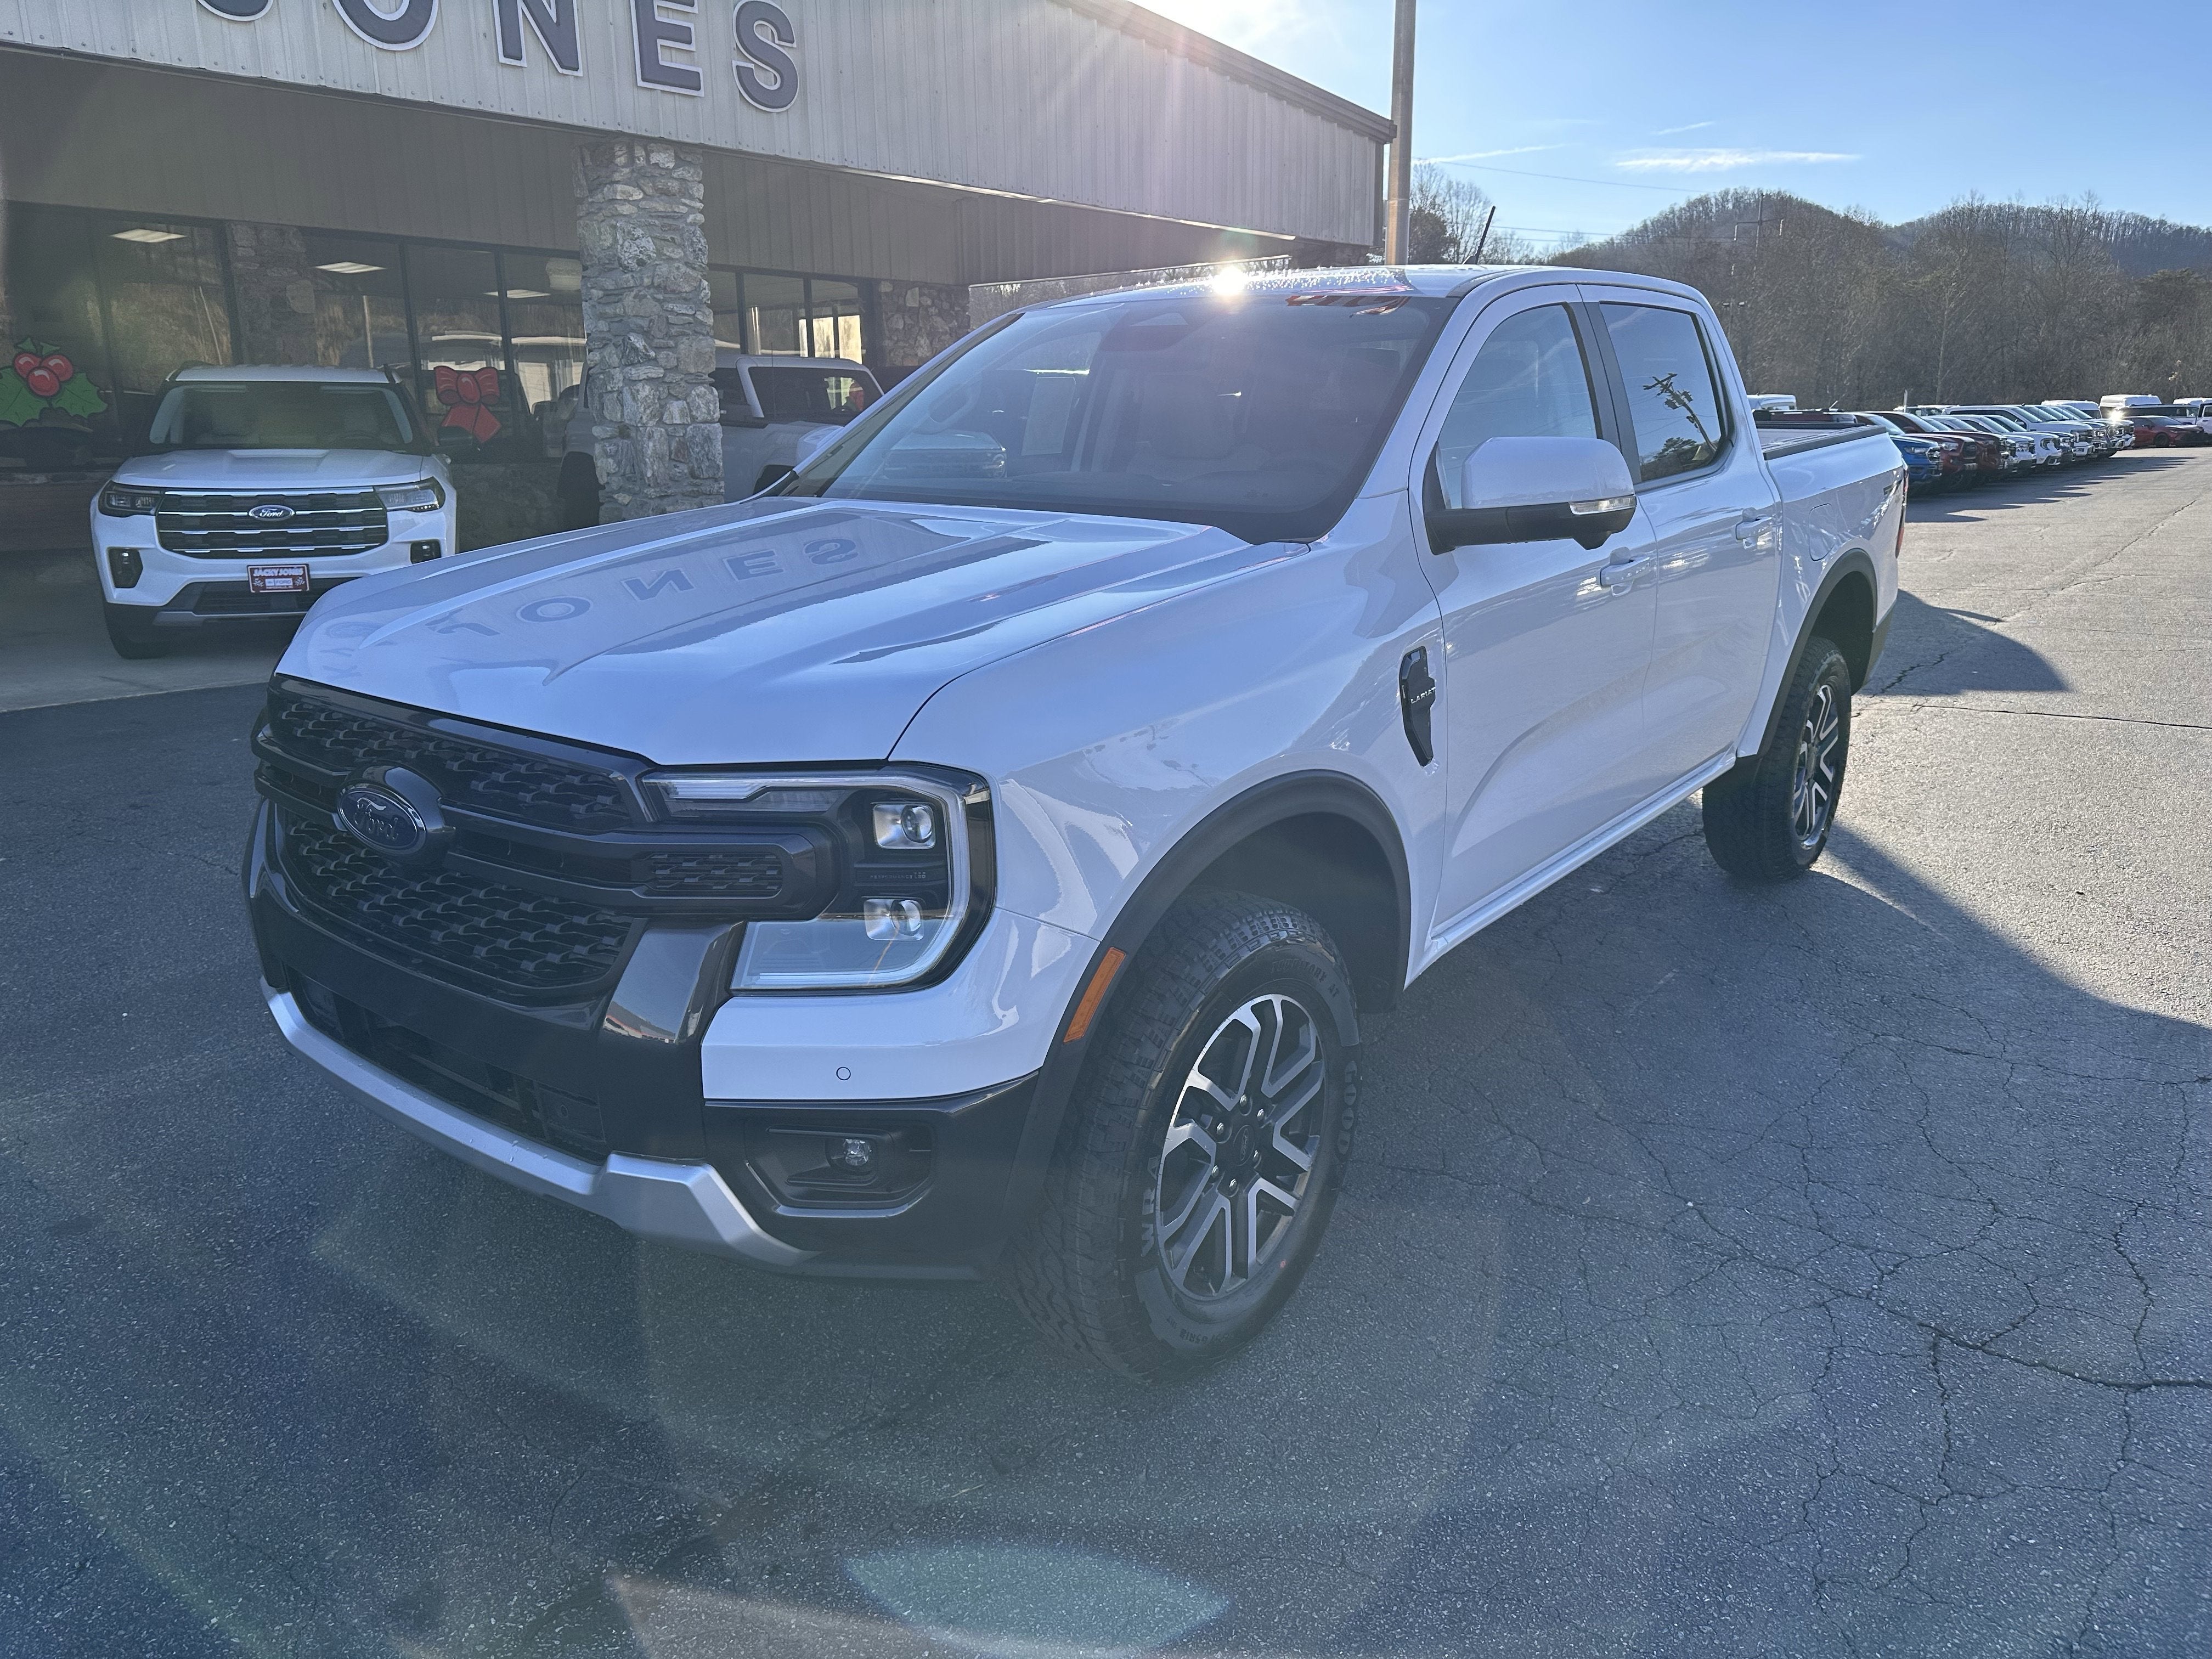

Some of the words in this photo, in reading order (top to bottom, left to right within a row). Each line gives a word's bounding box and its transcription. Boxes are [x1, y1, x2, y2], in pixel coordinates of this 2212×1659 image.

[197, 0, 799, 112] NES
[1410, 686, 1436, 704] LARIAT
[353, 797, 399, 841] Ford
